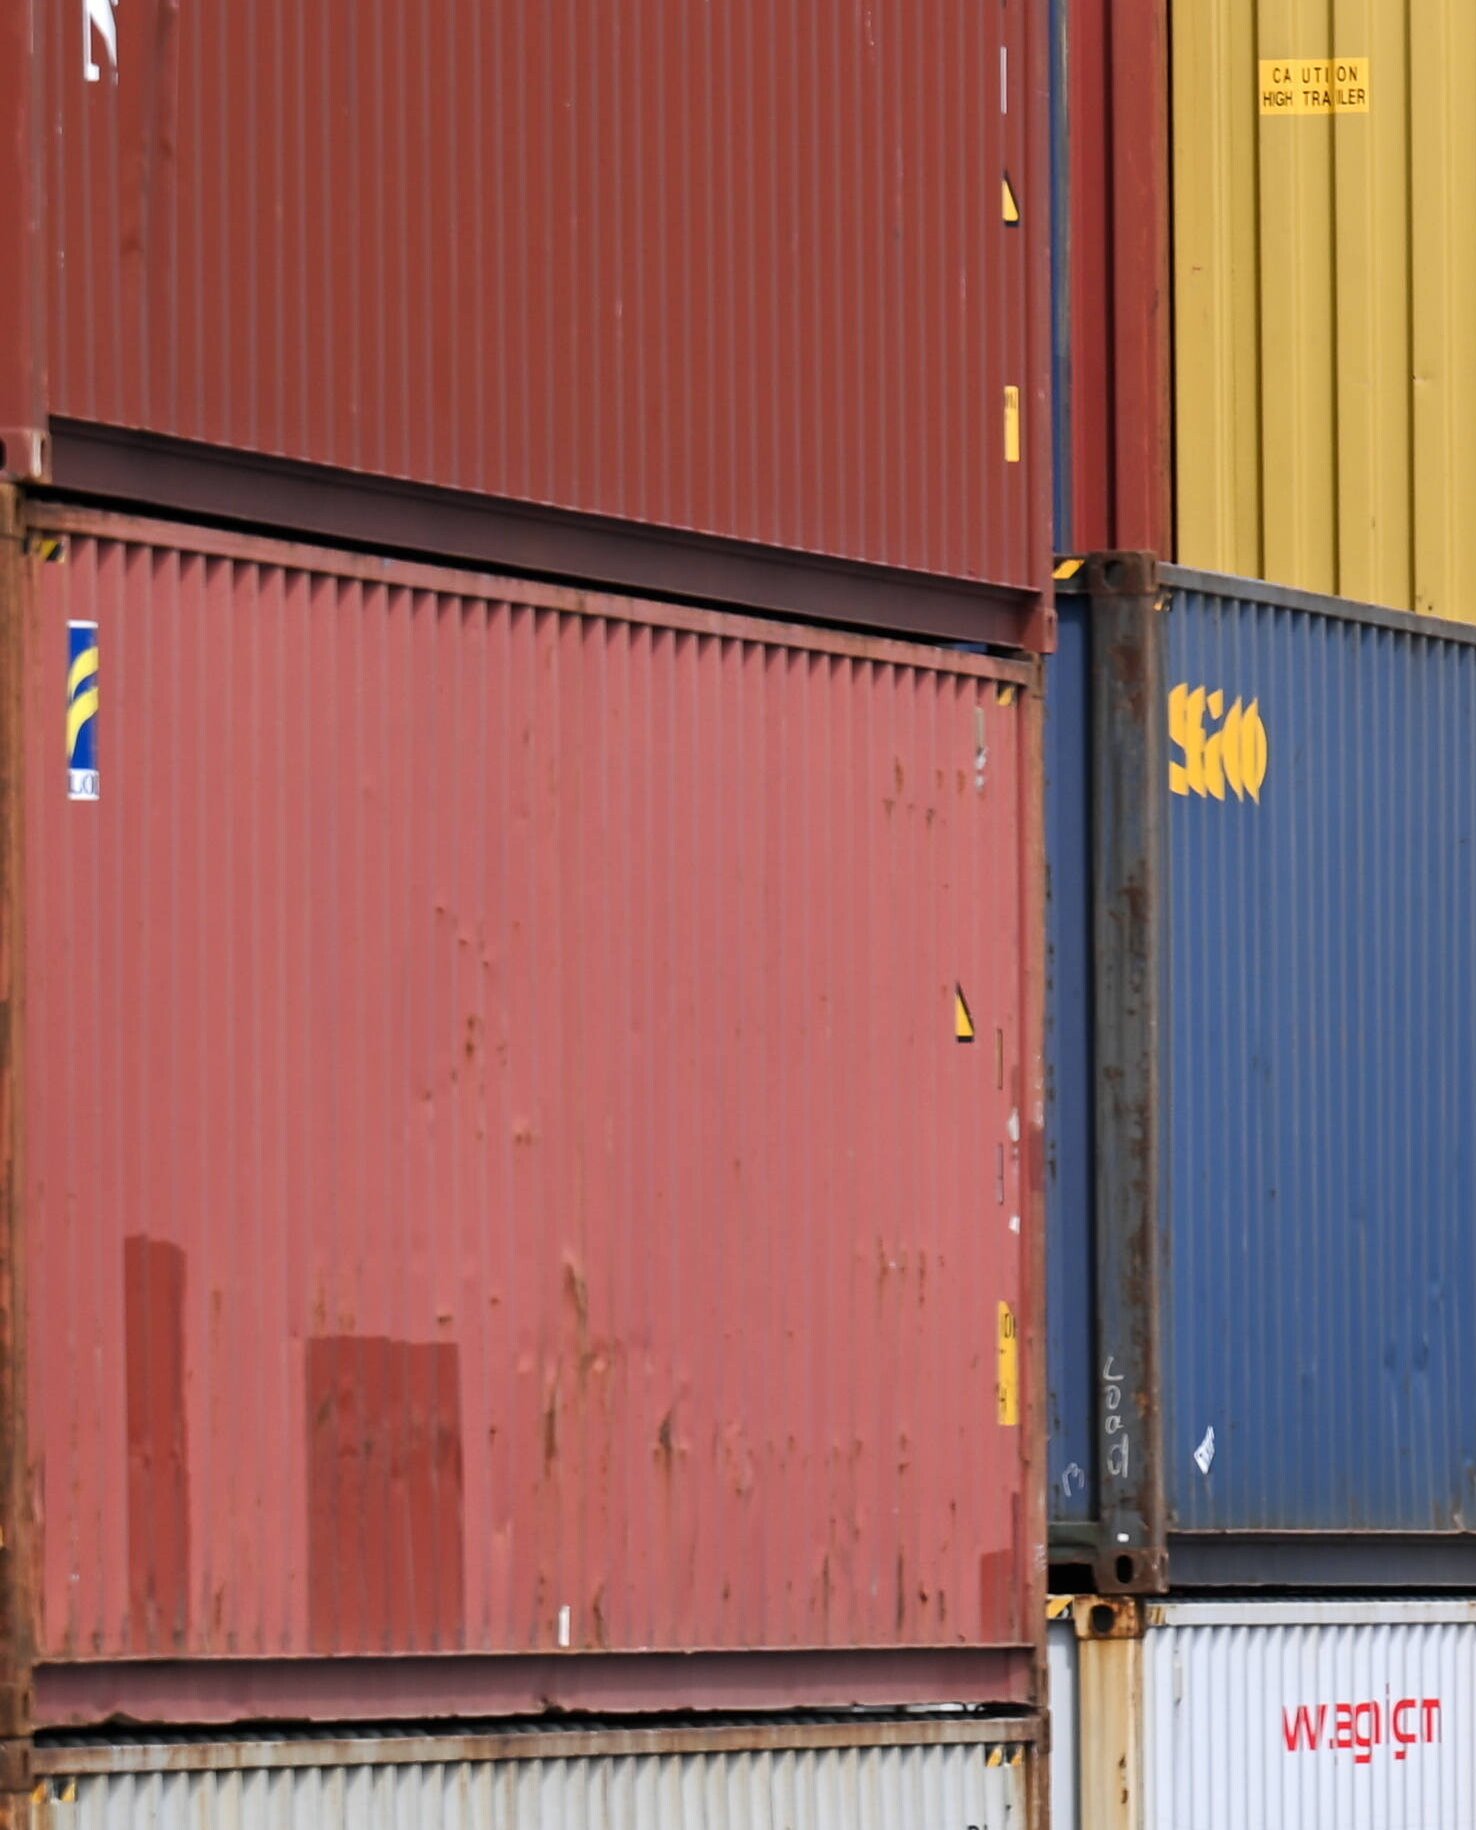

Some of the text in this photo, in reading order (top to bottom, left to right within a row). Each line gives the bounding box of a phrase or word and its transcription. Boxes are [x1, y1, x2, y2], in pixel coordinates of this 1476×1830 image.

[1272, 65, 1357, 84] CAUTION
[1263, 88, 1365, 107] HIGH TRAILER
